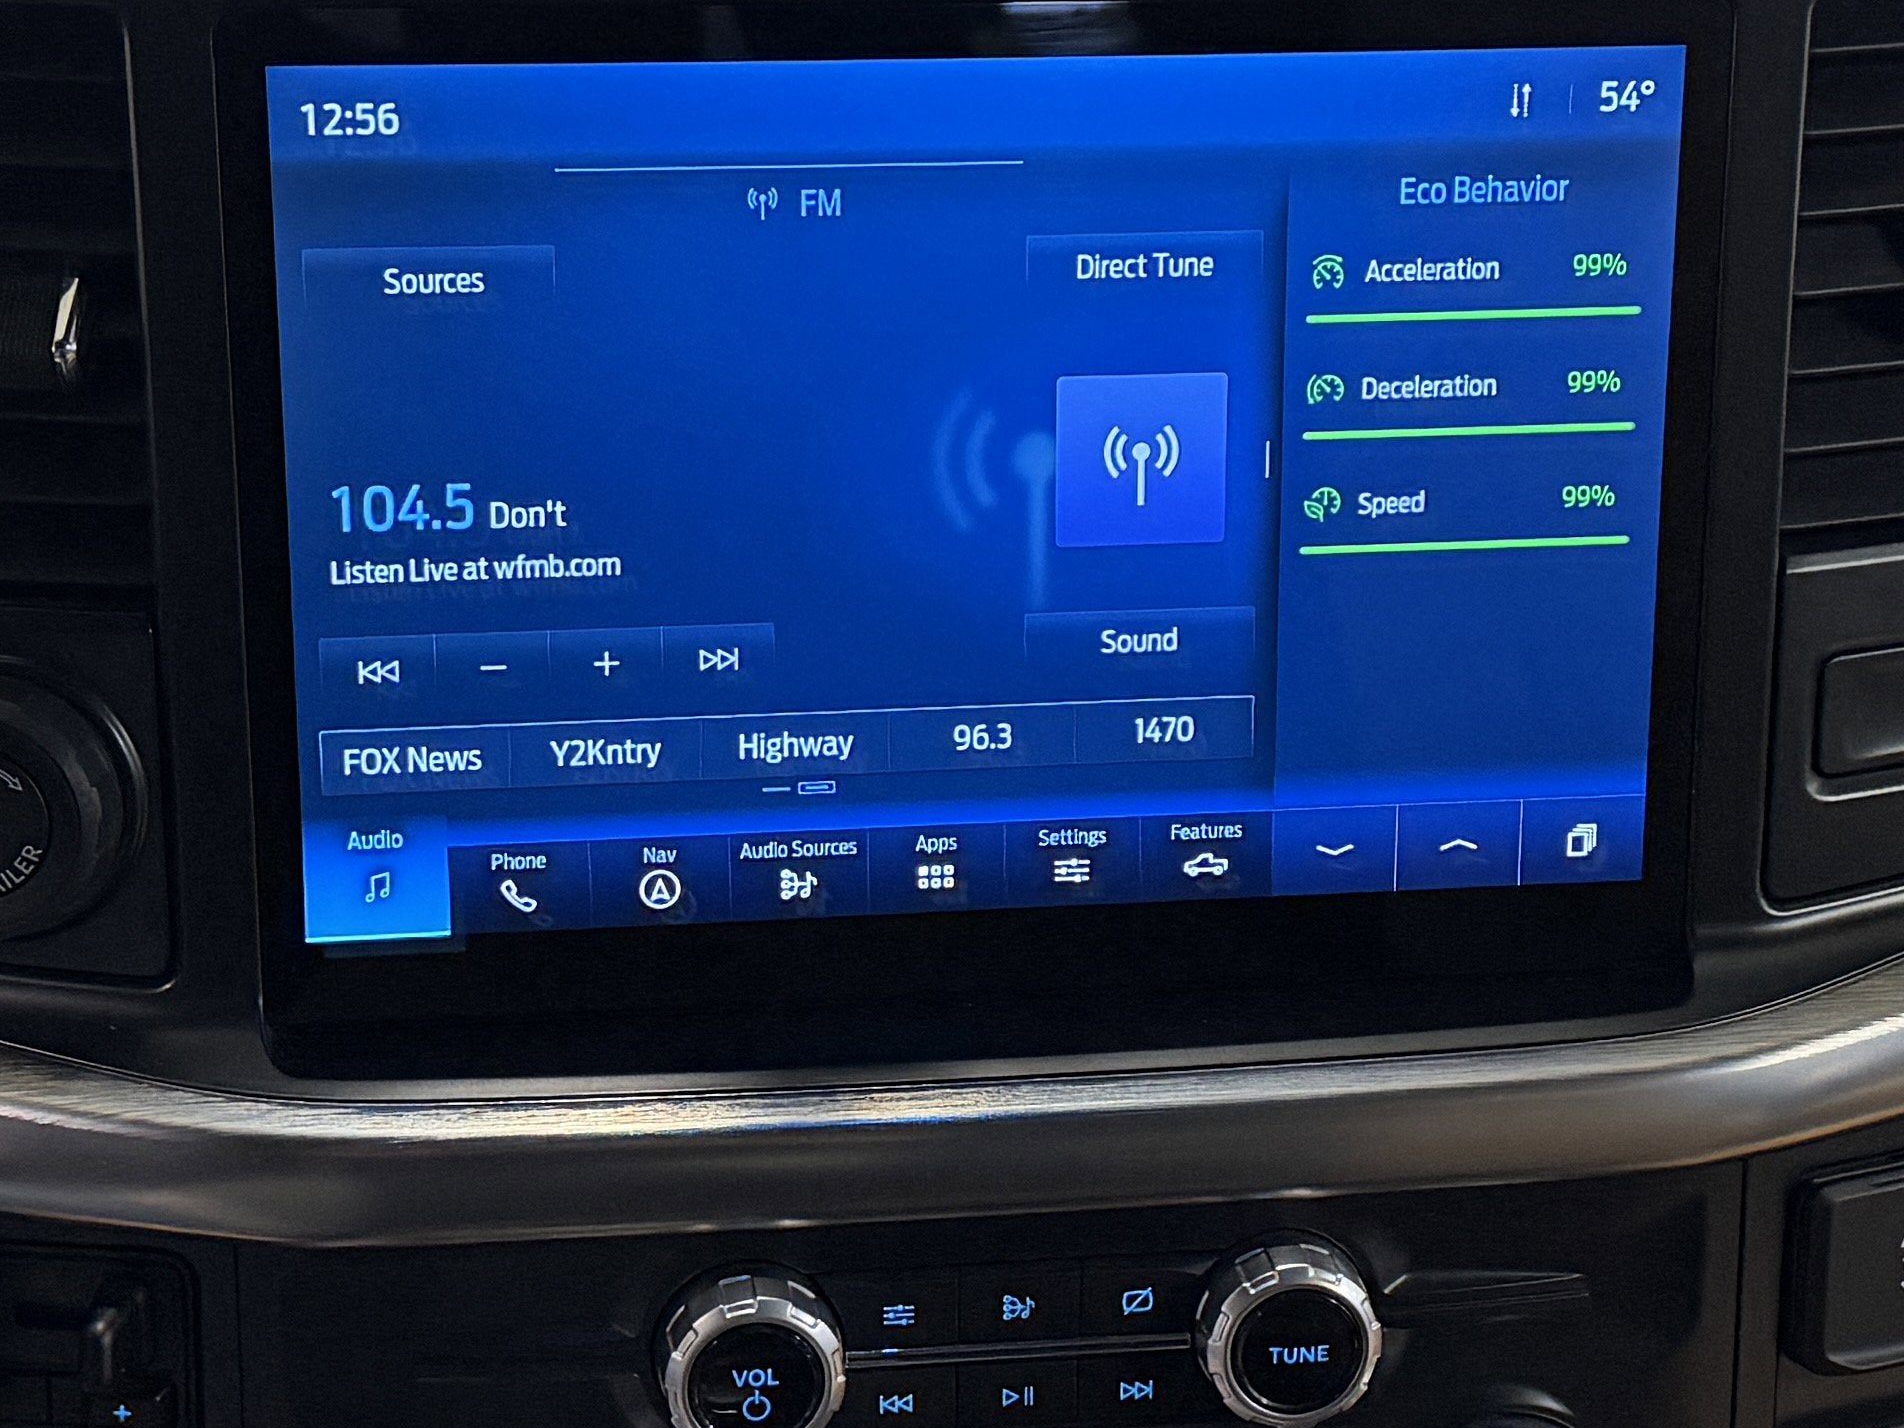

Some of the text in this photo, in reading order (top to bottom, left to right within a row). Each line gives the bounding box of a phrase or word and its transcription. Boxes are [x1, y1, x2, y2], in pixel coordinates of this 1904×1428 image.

[299, 101, 400, 136] 12:56
[799, 187, 843, 217] FM
[1398, 172, 1571, 205] Eco Behavior
[1075, 251, 1215, 280] Direct Tune
[1363, 257, 1501, 284] Acceleration
[1572, 251, 1628, 278] 99%
[381, 266, 486, 296] Sources
[1360, 373, 1498, 402] Deceleration
[1566, 369, 1622, 395] 99%
[330, 481, 568, 534] 104.5 Don't
[1357, 489, 1427, 519] Speed
[1561, 484, 1617, 510] 99%
[329, 552, 622, 586] Listen Live at wfmb.com
[1099, 625, 1180, 655] Sound
[952, 723, 1014, 753] 96.3
[1133, 714, 1196, 745] 1470
[342, 743, 484, 778] FOX News
[549, 736, 663, 770] Y2Kntry
[737, 731, 855, 764] Highway
[346, 828, 405, 853] Audio
[914, 833, 958, 856] Apps
[1037, 824, 1108, 849] Settings
[1169, 819, 1244, 843] Features
[489, 850, 548, 872] Phone
[642, 844, 678, 865] Nav
[738, 835, 859, 860] Audio Sources
[1268, 1343, 1330, 1365] TUNE
[731, 1368, 780, 1388] VOL
